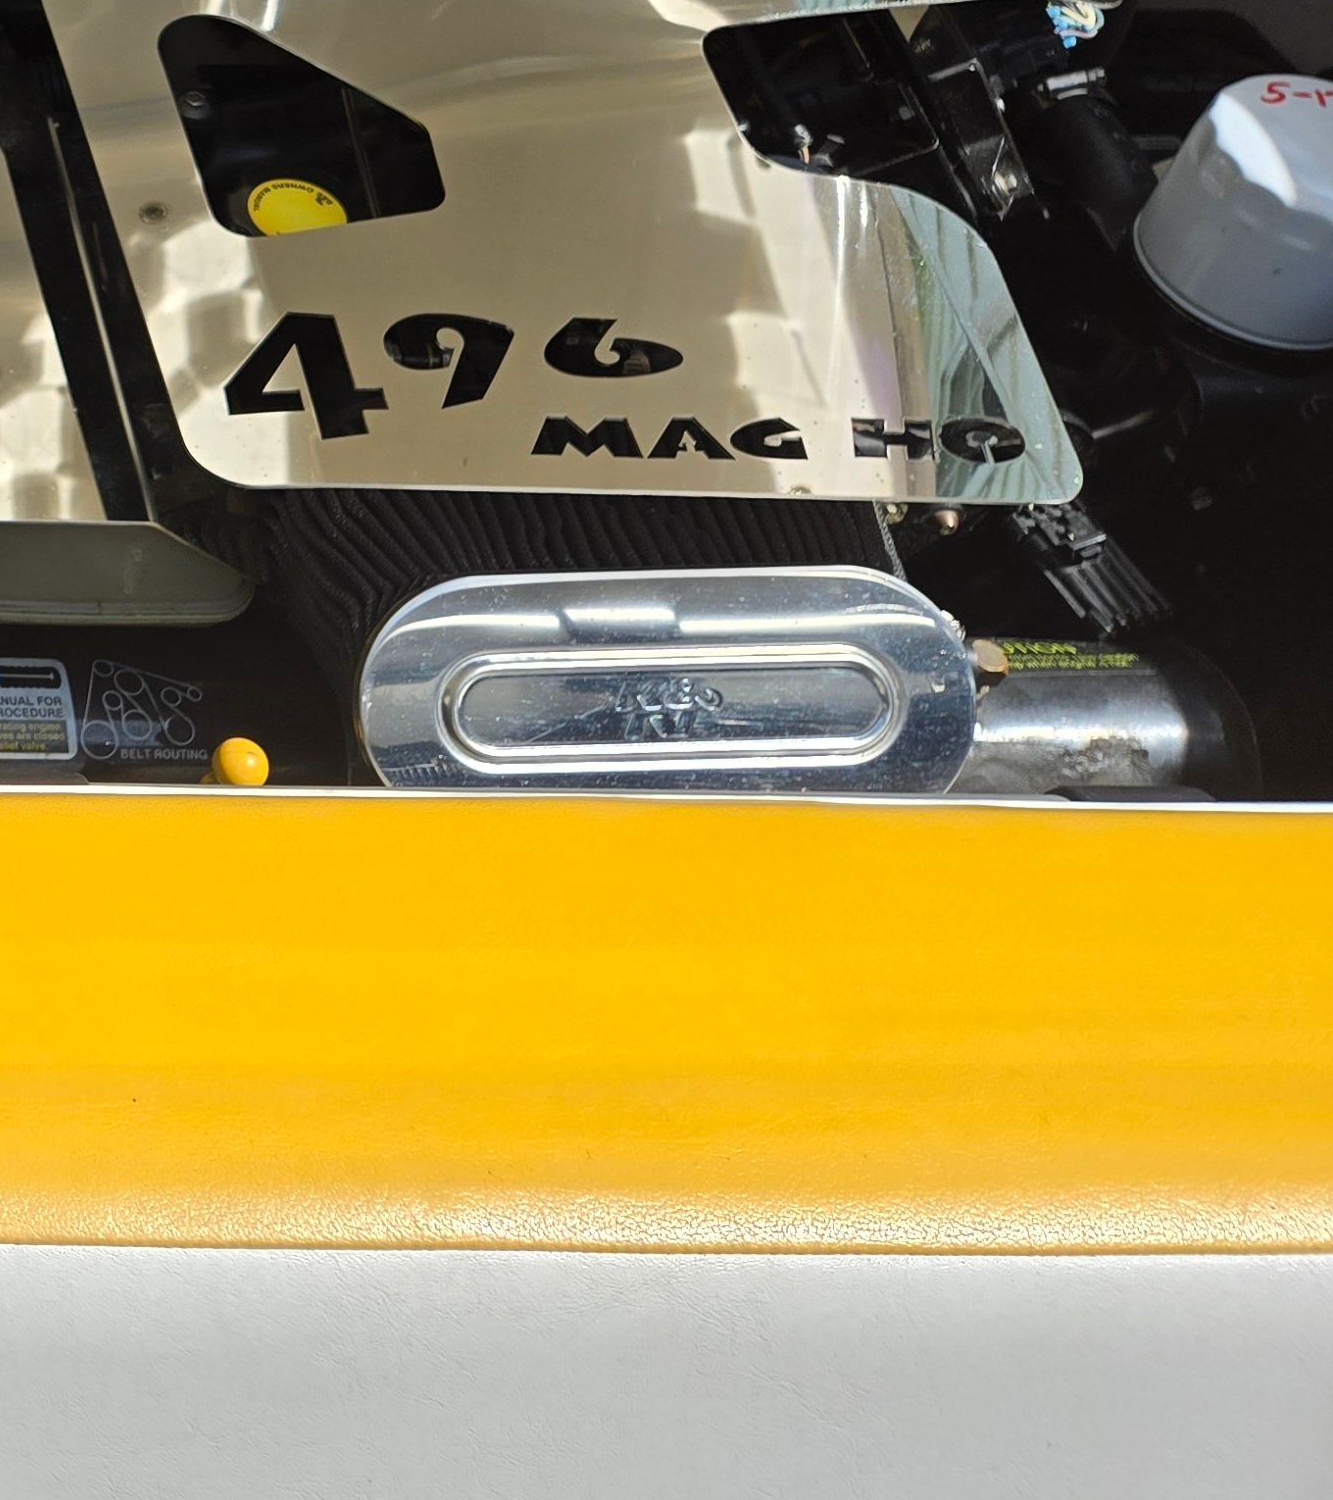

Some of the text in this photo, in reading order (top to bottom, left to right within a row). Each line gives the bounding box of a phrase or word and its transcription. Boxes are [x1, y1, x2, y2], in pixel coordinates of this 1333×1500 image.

[226, 311, 685, 440] 496
[531, 415, 1026, 465] MAG HO
[37, 696, 62, 706] FOR
[16, 732, 31, 740] are
[120, 748, 208, 760] BELT ROUTING
